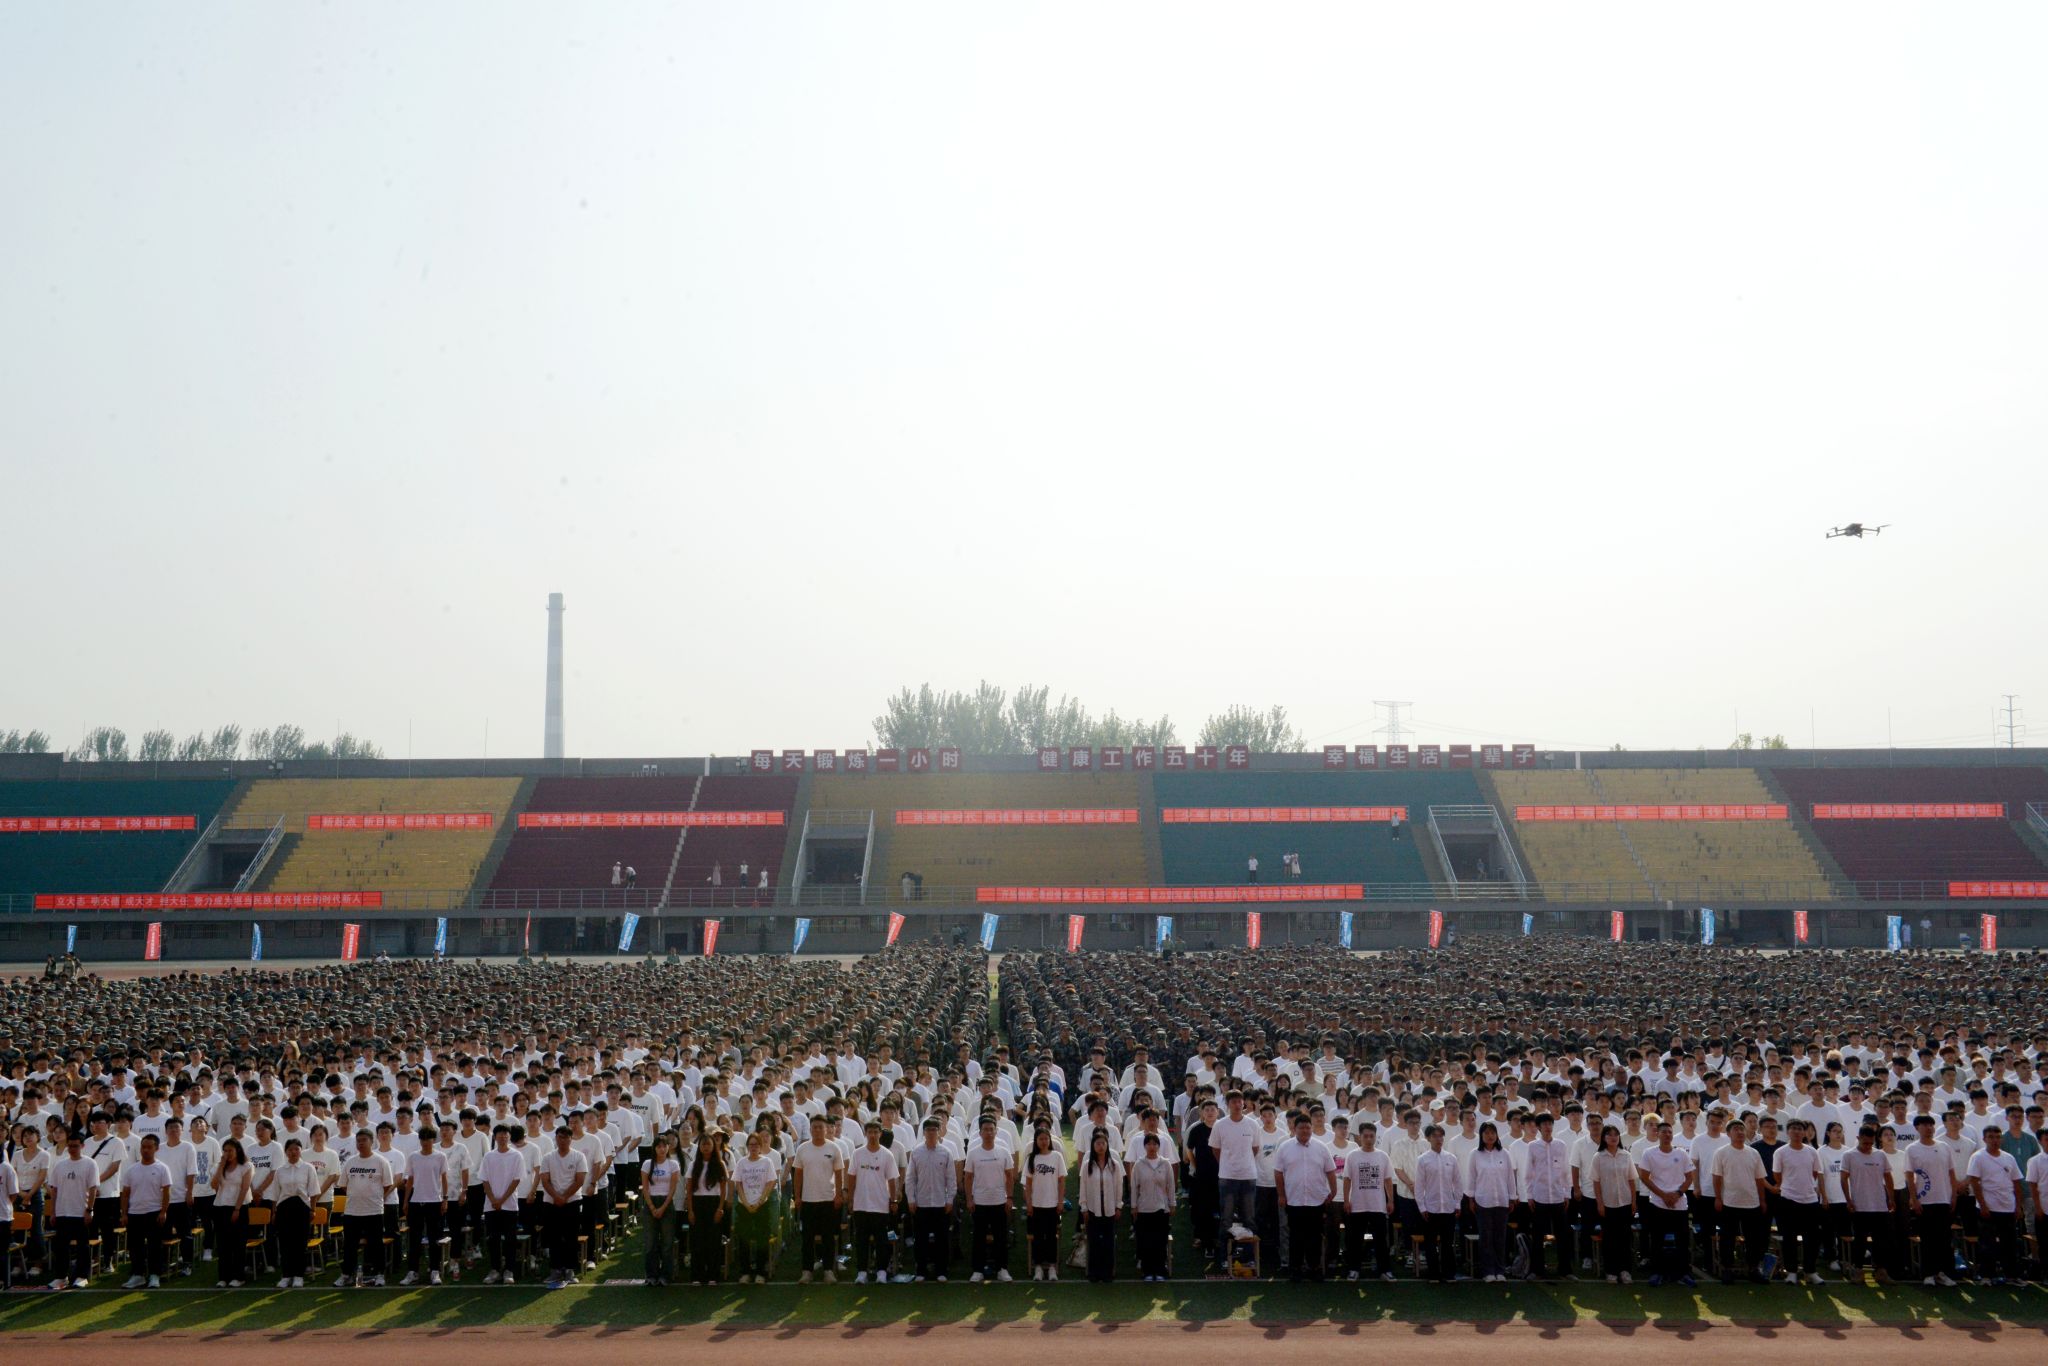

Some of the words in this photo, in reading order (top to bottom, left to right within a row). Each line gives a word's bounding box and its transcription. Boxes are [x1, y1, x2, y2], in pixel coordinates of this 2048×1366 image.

[754, 751, 960, 771] 每天锻炼一小时
[1040, 749, 1248, 769] 健康工作五十年
[1326, 747, 1535, 767] 幸福生活一辈子
